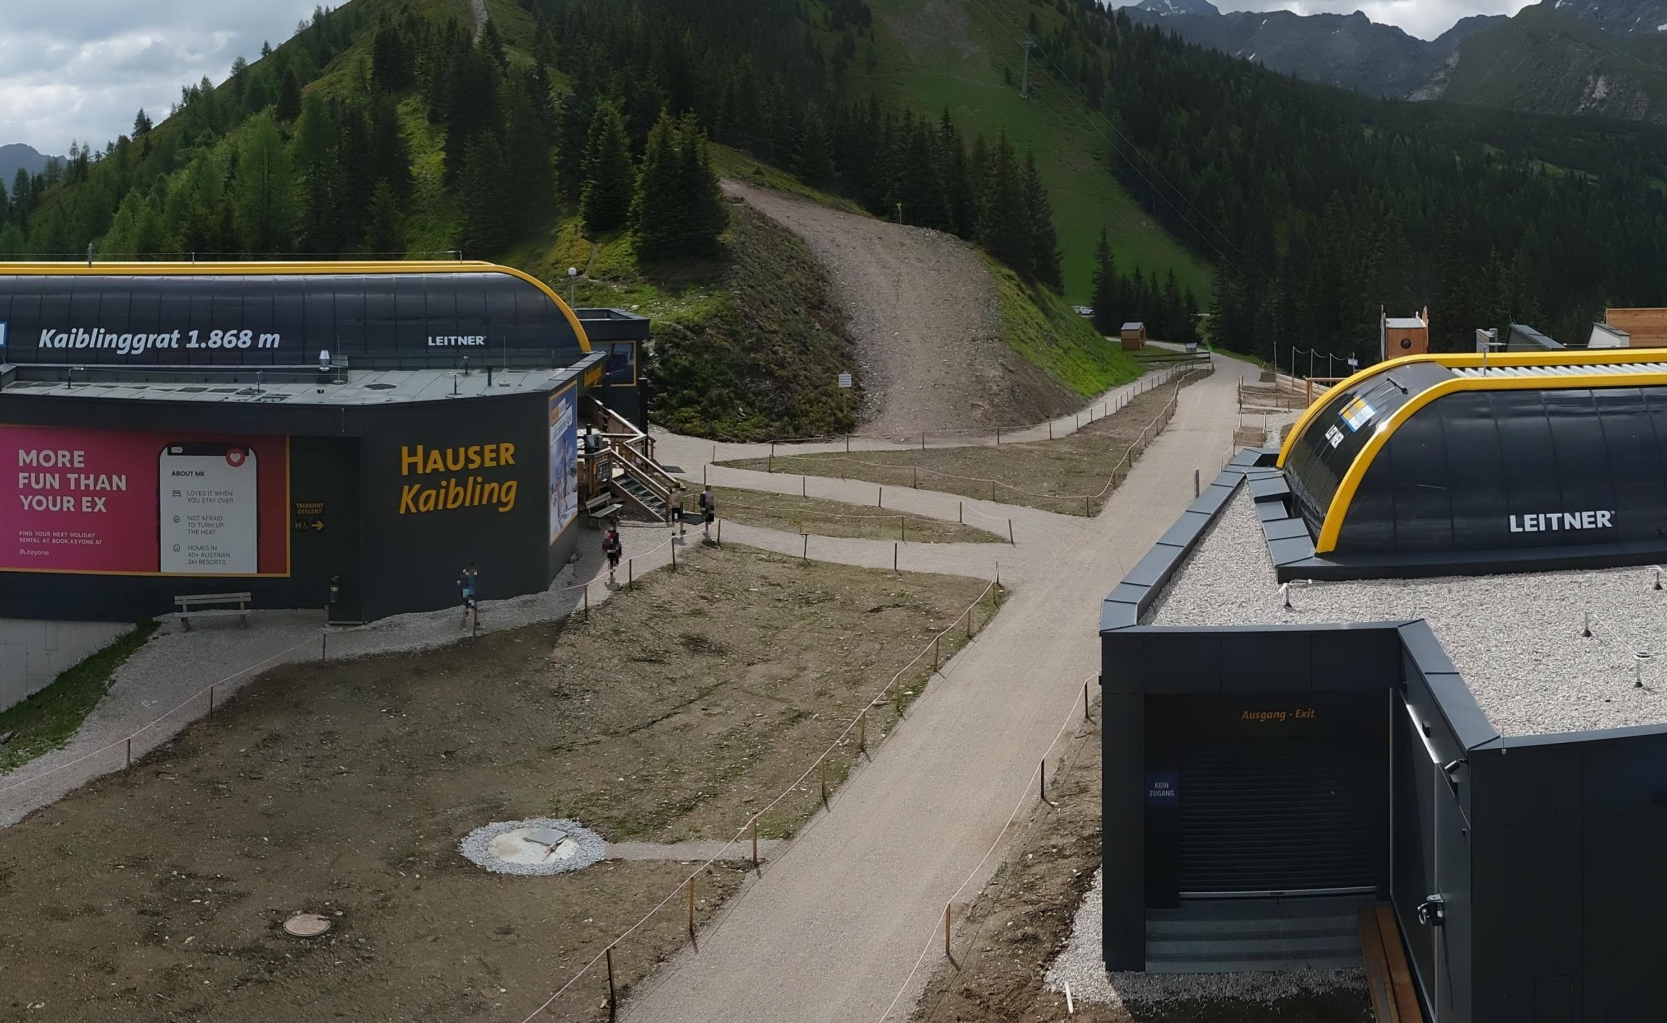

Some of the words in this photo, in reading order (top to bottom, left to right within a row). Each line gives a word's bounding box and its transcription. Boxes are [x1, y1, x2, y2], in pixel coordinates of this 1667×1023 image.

[38, 328, 180, 355] Kaiblinggrat
[185, 329, 253, 349] 1.868
[258, 333, 280, 349] m
[427, 335, 486, 346] LEITNER
[18, 449, 85, 468] MORE
[401, 442, 516, 476] HAUSER
[18, 472, 60, 490] FUN
[66, 473, 127, 491] THAN
[19, 495, 75, 512] YOUR
[81, 496, 107, 513] EX
[399, 476, 518, 515] Kaibling
[1509, 510, 1613, 533] LEITNER
[26, 549, 49, 557] keyone
[1241, 710, 1287, 722] Ausgang
[1295, 708, 1316, 719] Exit
[1149, 789, 1175, 797] ZUGANG
